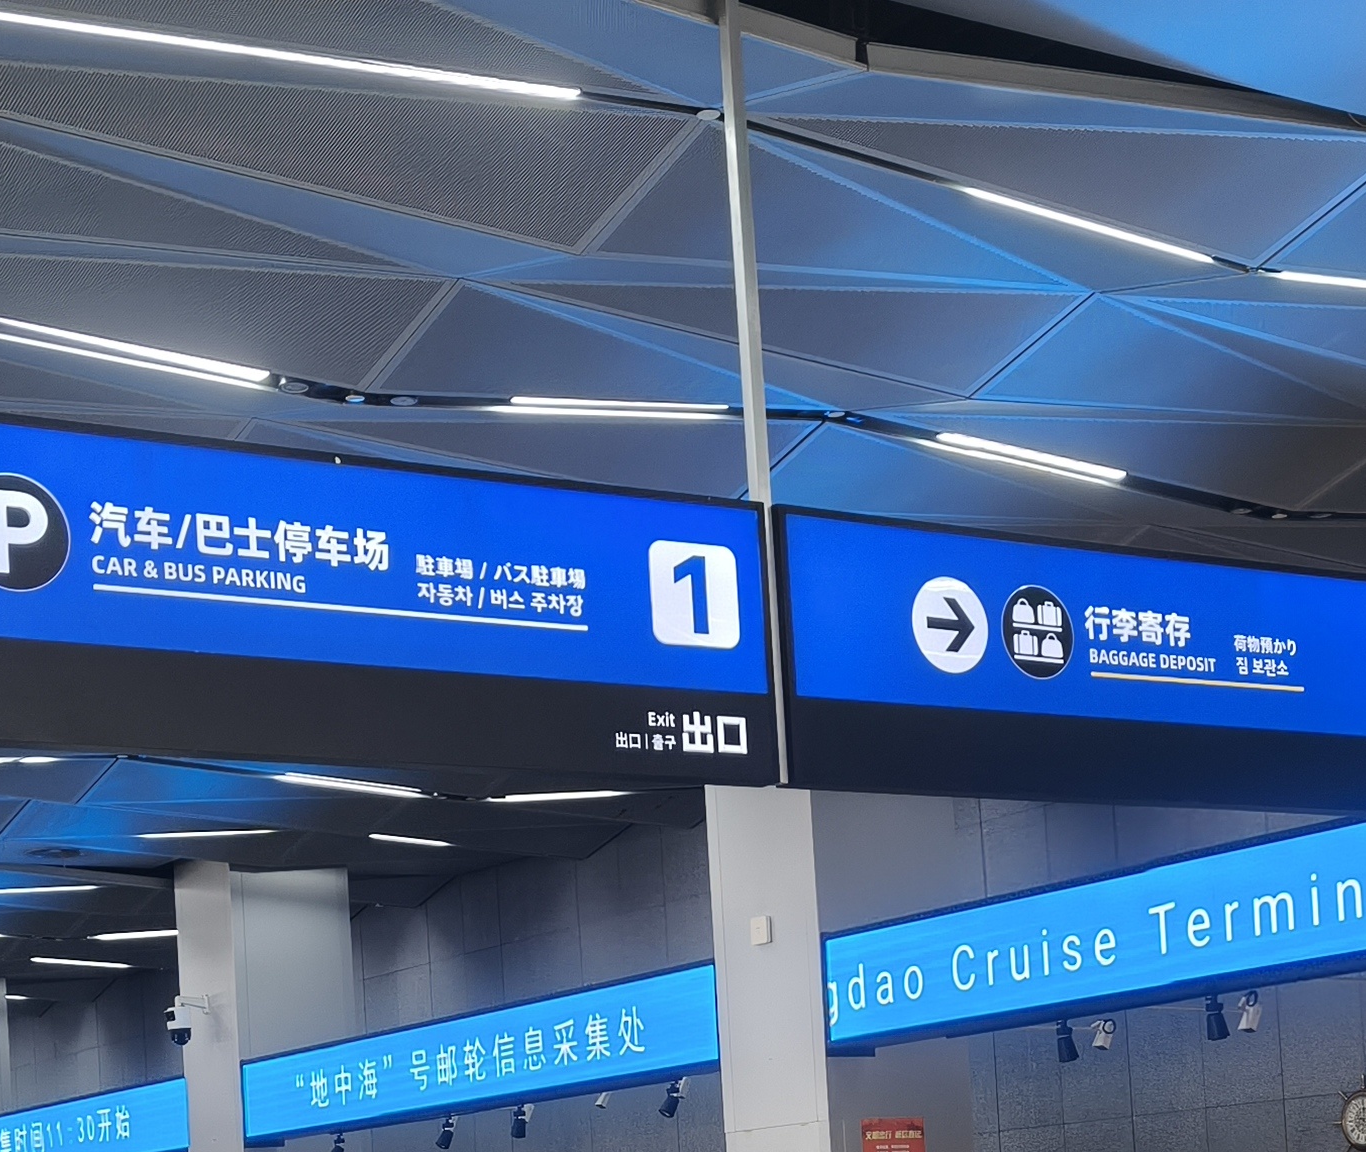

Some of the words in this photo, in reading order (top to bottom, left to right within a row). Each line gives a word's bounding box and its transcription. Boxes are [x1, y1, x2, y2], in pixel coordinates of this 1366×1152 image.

[89, 501, 389, 571] 汽车/巴士停车场
[91, 554, 137, 577] CAR
[143, 560, 159, 579] &
[164, 560, 206, 583] BUS
[212, 568, 306, 594] PARKING
[415, 554, 473, 579] 駐車場
[493, 562, 586, 590] バス駐車場
[417, 583, 473, 606] 자동차
[490, 589, 525, 609] 버스
[530, 592, 583, 617] 주차장
[674, 555, 709, 634] 1
[1084, 605, 1191, 647] 行李寄存
[1089, 648, 1156, 668] BAGGAGE
[1160, 656, 1216, 673] DEPOSIT
[1233, 634, 1297, 656] 荷物預かり
[1236, 656, 1249, 675] 짐
[1252, 658, 1289, 677] 보관소
[647, 711, 676, 727] Exit
[682, 711, 748, 754] 出口
[615, 731, 641, 749] 出口
[951, 927, 1117, 990] Cruise
